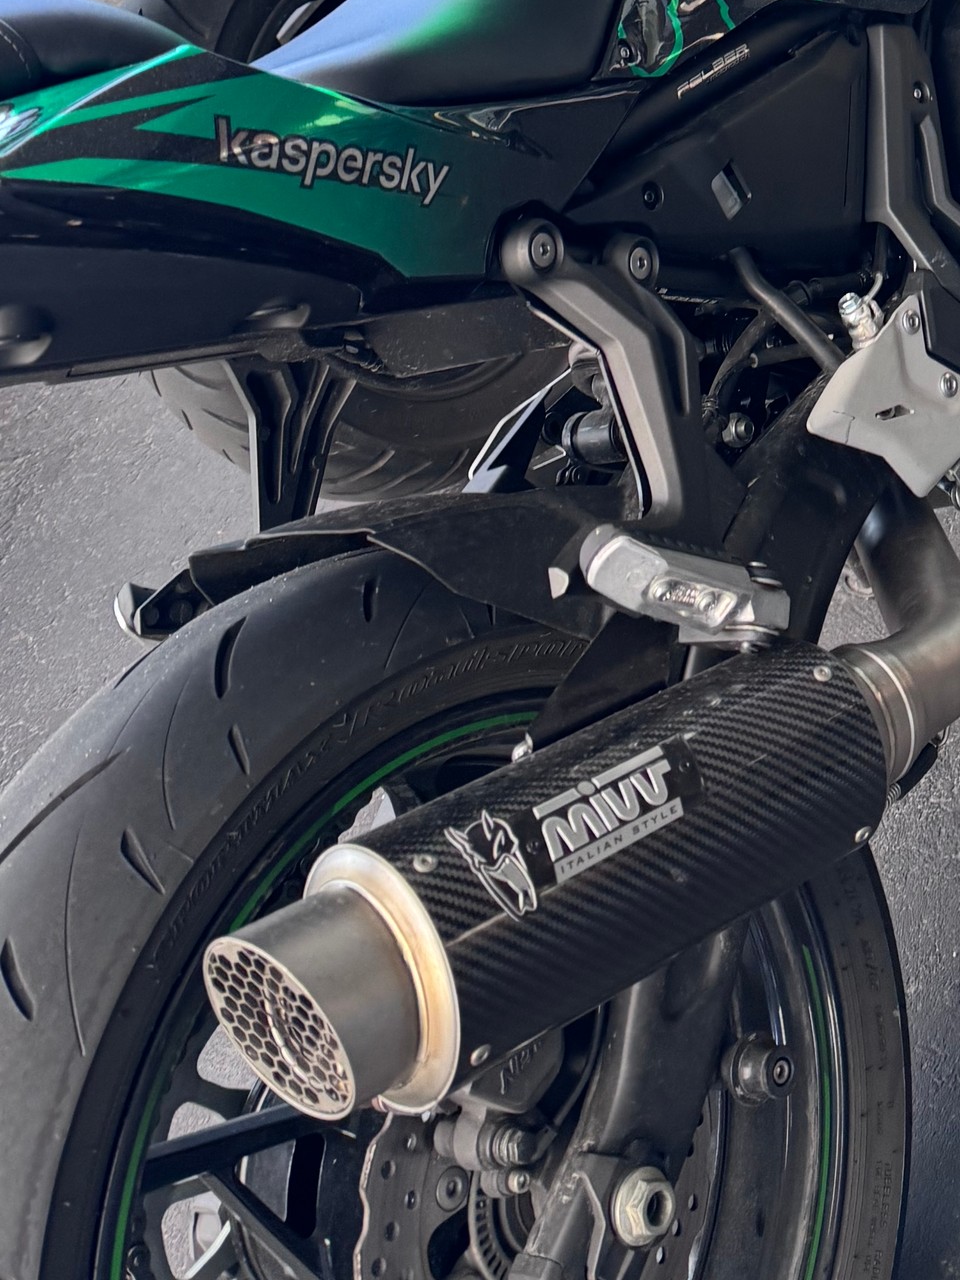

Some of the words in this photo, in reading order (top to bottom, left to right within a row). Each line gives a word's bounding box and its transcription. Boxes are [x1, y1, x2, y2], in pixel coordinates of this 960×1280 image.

[215, 116, 451, 205] kaspersky
[559, 833, 623, 874] ITALIAN
[631, 803, 679, 837] STYLE
